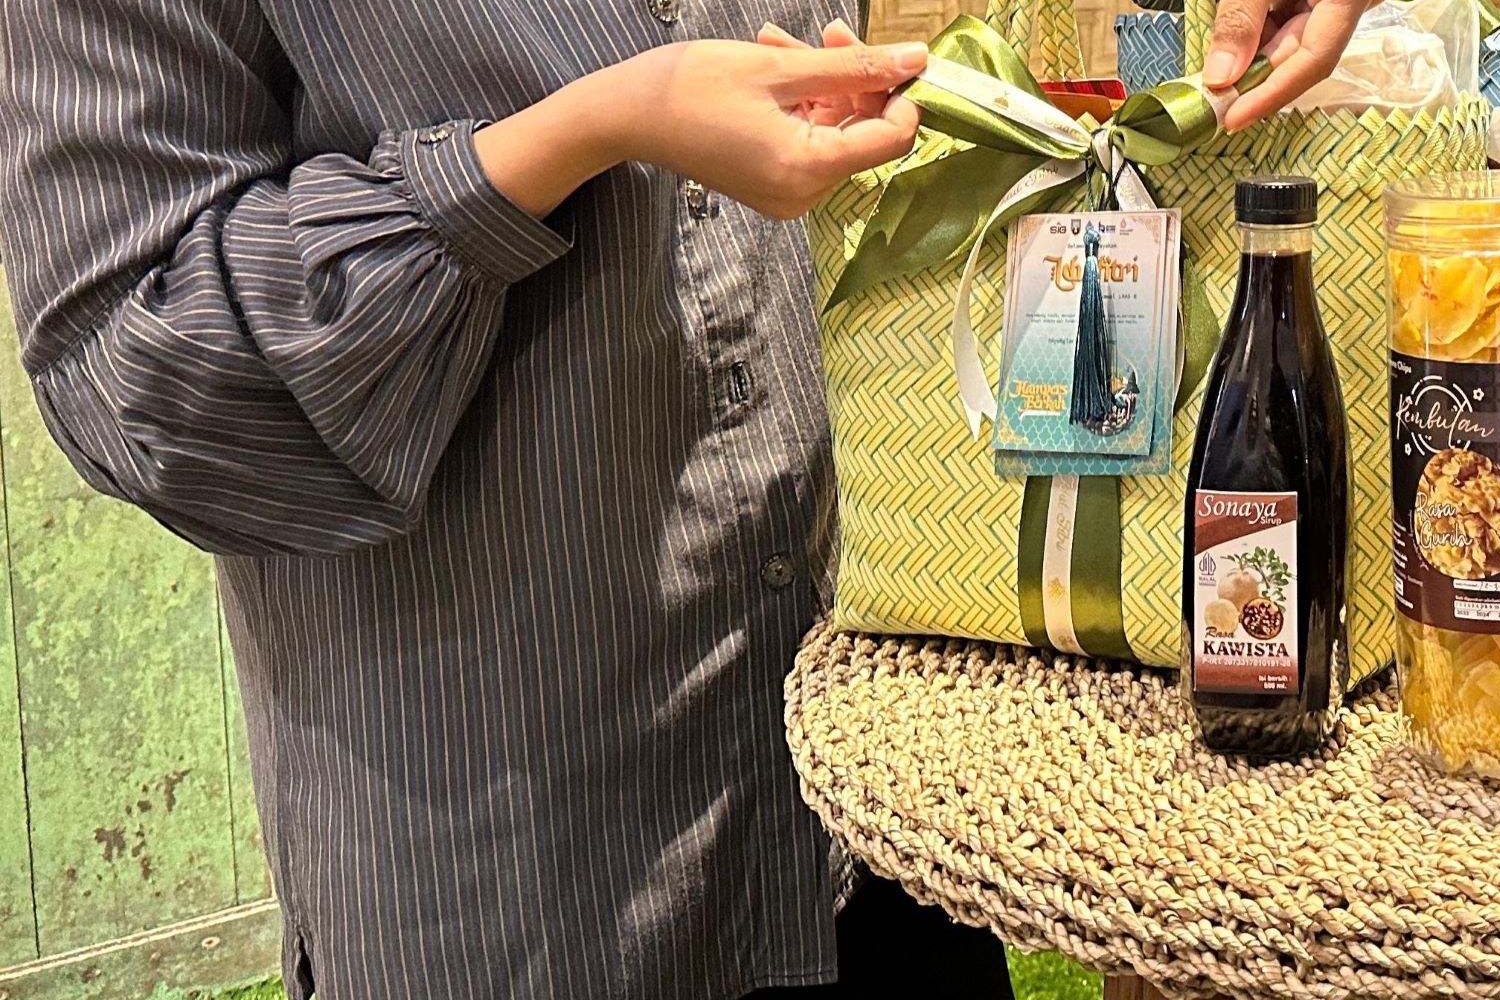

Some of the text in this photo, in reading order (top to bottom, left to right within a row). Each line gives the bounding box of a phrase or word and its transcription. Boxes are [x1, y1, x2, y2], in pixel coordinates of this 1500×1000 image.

[1198, 494, 1278, 525] Sonaya
[1415, 491, 1456, 520] Rasa
[1260, 515, 1283, 526] Sirup
[1420, 520, 1473, 550] Gurih
[1205, 626, 1235, 639] Rasa
[1203, 640, 1290, 657] KAWISTA
[1267, 674, 1288, 682] bersih
